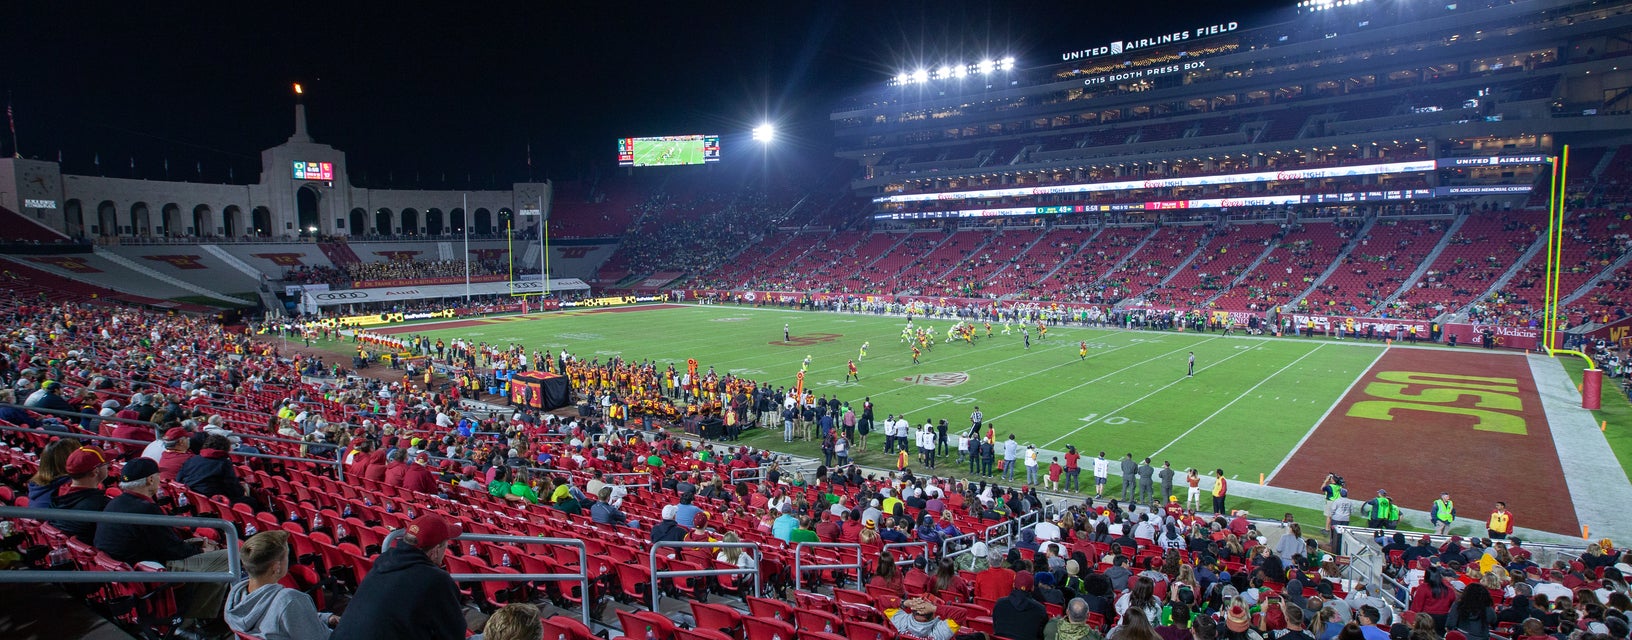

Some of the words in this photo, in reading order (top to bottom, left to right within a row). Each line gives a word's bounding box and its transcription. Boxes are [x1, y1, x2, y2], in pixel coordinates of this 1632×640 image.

[1062, 46, 1108, 61] UNITED
[1125, 31, 1190, 50] AIRLINES
[1197, 22, 1238, 37] FIELD
[1084, 76, 1106, 86] OTIS
[1109, 71, 1142, 82] BOOTH
[1147, 65, 1179, 76] PRESS
[1184, 61, 1206, 70] BOX
[1472, 334, 1482, 343] of
[1496, 326, 1537, 338] Medicine
[1609, 325, 1630, 343] WE
[926, 394, 976, 404] 20
[1344, 370, 1529, 436] USC
[1078, 413, 1130, 425] 10
